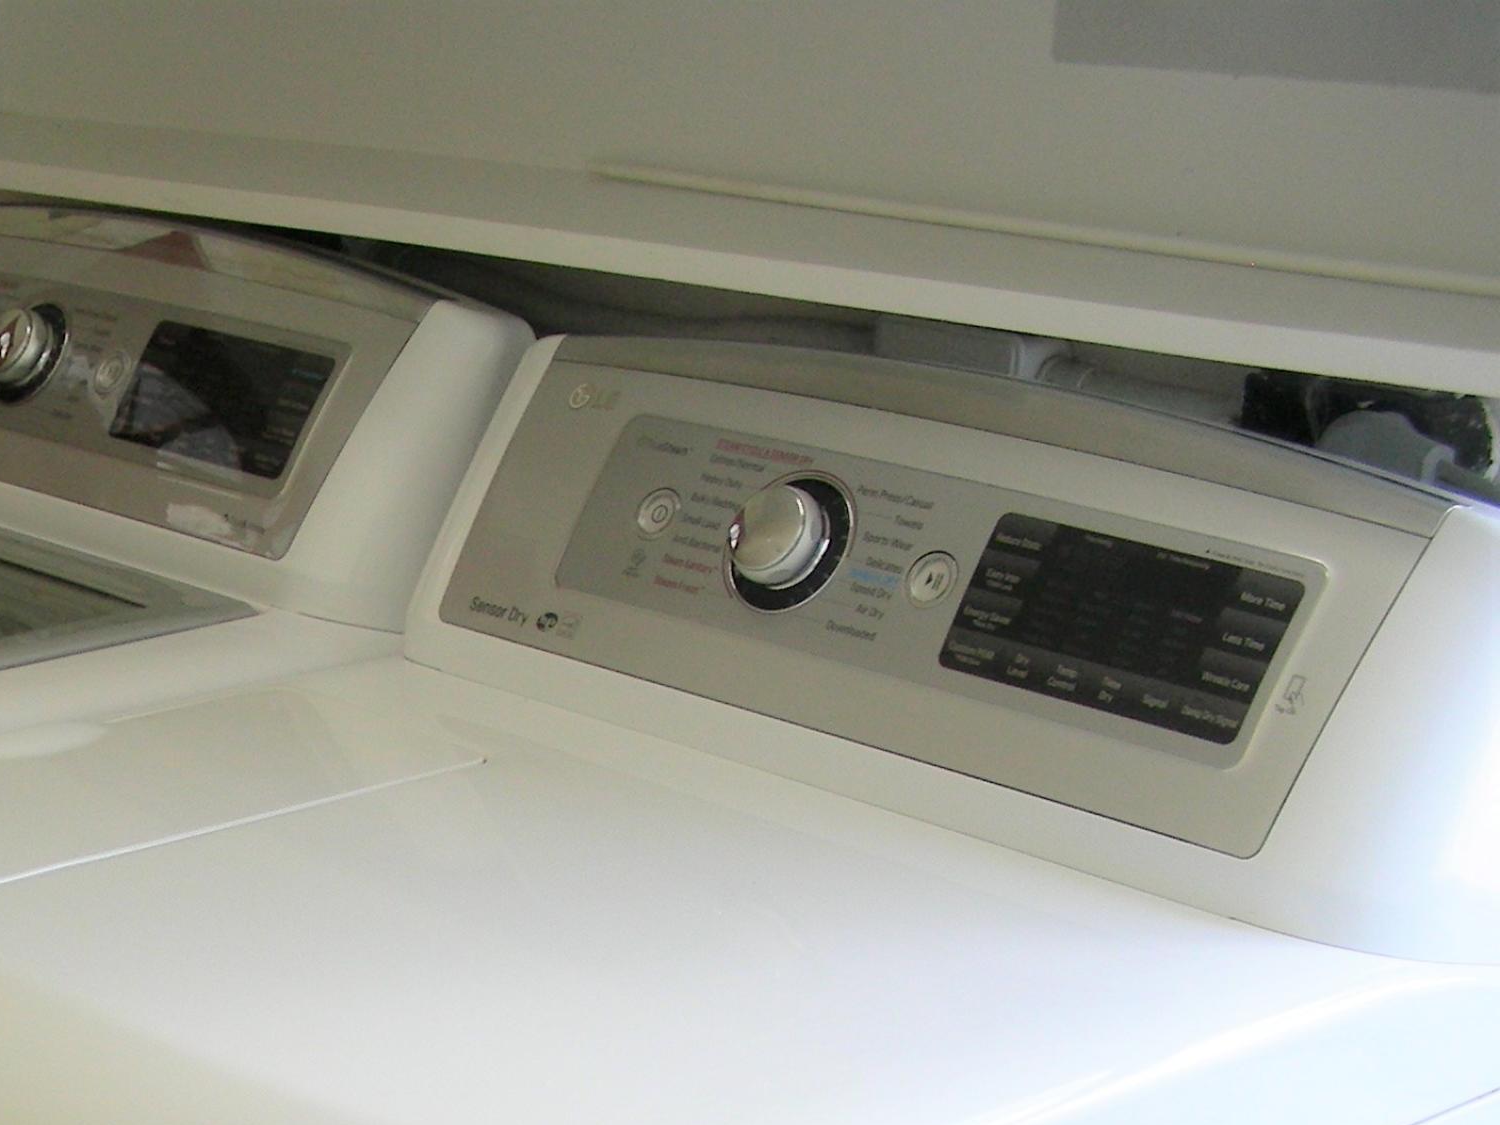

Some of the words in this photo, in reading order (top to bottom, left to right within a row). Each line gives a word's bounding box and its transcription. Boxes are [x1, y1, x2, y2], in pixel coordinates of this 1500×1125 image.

[469, 595, 508, 619] Sensor
[508, 605, 530, 628] Dry
[1240, 591, 1264, 606] More
[1264, 596, 1286, 612] Time
[1243, 636, 1266, 652] Time
